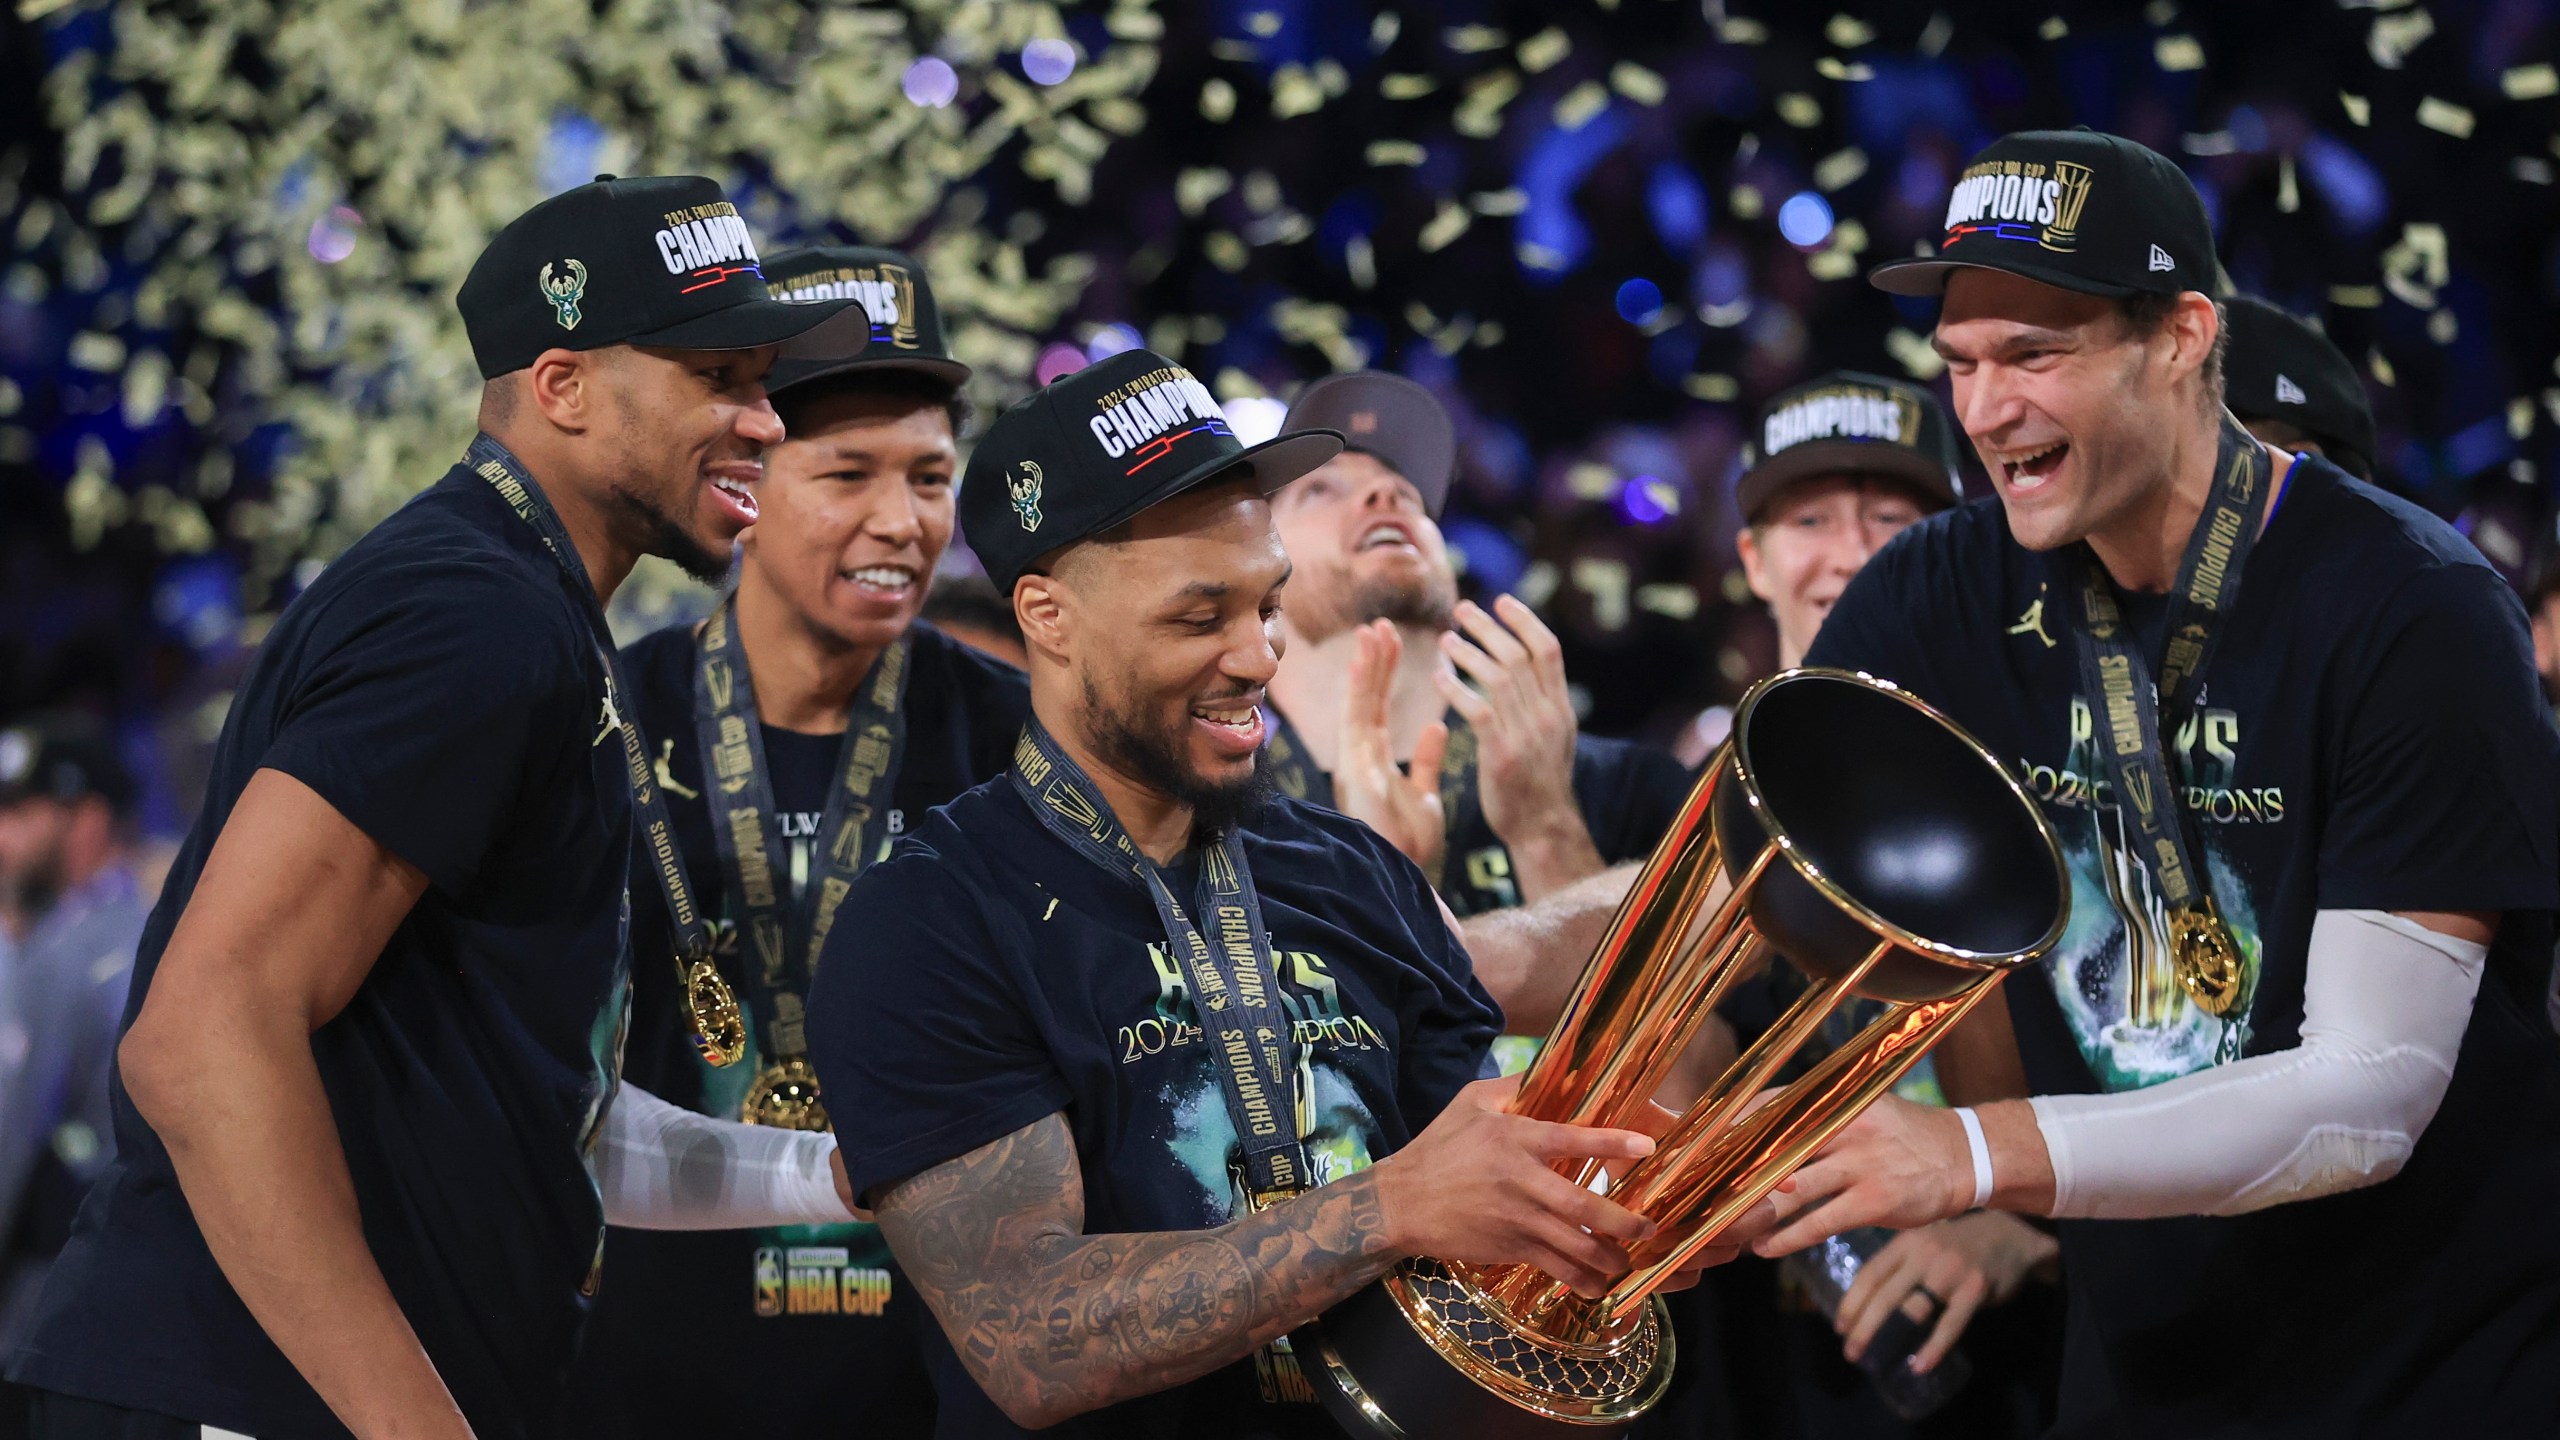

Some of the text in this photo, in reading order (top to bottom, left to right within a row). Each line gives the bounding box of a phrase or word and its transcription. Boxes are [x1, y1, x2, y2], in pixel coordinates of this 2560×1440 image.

[2024, 162, 2046, 177] CUP
[664, 208, 694, 227] 2024
[655, 215, 760, 275] CHAMPI
[1097, 388, 1128, 411] 2024
[1125, 367, 1173, 396] EMIRATES
[1765, 396, 1900, 456] CHAMPIONS
[476, 460, 529, 507] NBA CUP
[2189, 506, 2242, 611] CHAMPIONS
[2099, 655, 2143, 756] CHAMPIONS
[622, 722, 640, 754] CUP
[632, 751, 651, 785] NBA
[650, 820, 694, 926] CHAMPIONS
[1187, 930, 1227, 992] NBA CUP
[1217, 906, 1267, 1009] CHAMPIONS
[1221, 1029, 1276, 1136] CHAMPIONS
[1271, 1154, 1295, 1187] CUP
[786, 1267, 892, 1316] NBA CUP
